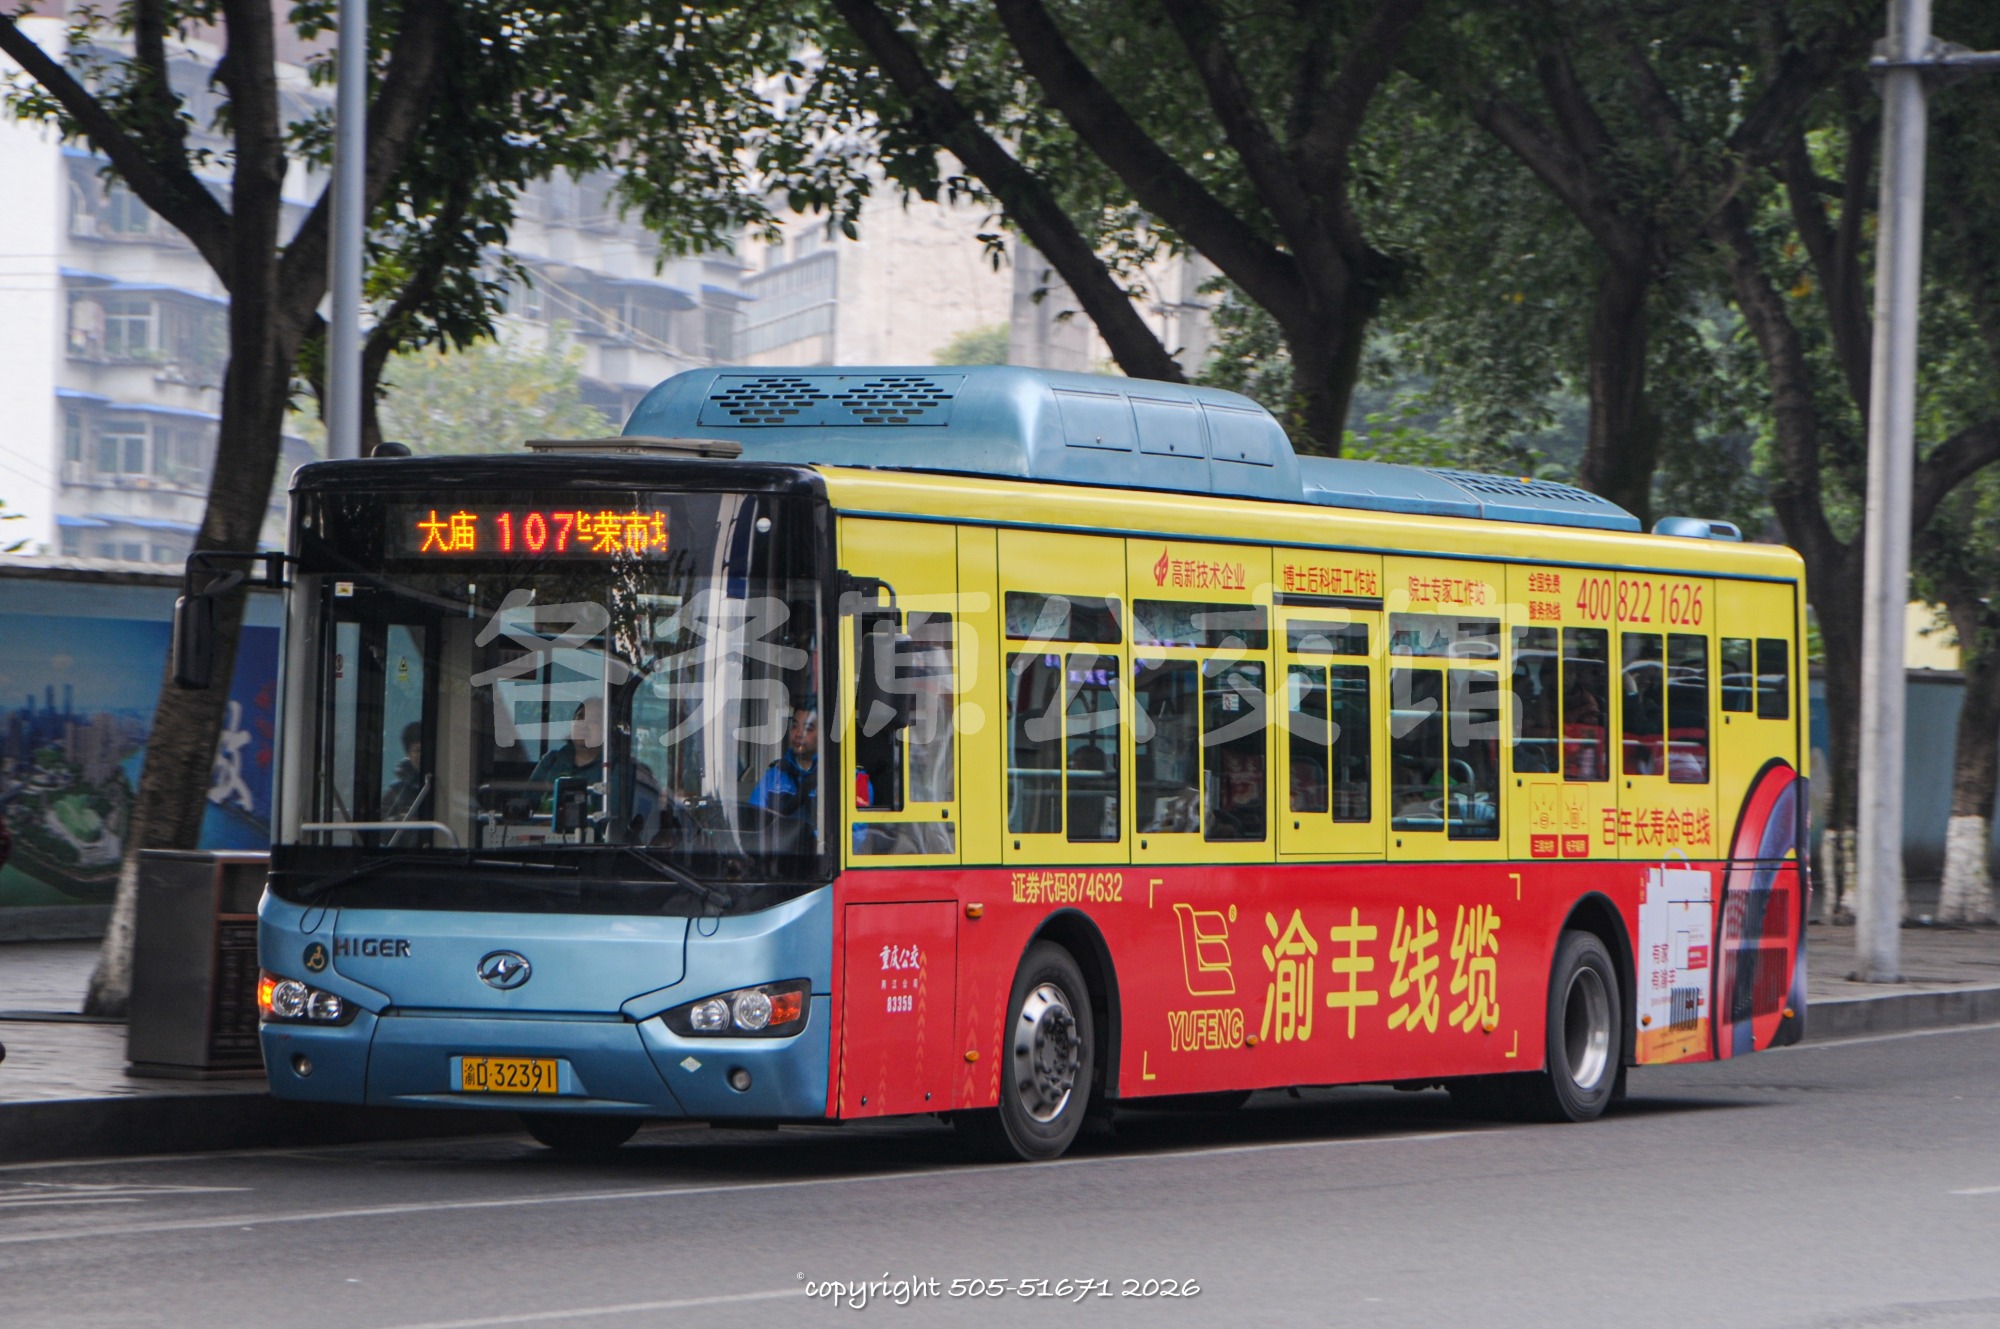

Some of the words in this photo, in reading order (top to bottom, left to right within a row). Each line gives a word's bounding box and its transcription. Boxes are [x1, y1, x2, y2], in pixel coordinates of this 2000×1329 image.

[418, 510, 476, 551] 大庙
[498, 512, 574, 552] 107
[1171, 560, 1246, 590] 高新技术企业
[1283, 564, 1377, 595] 博士后科研工作站
[1528, 572, 1561, 594] 全国免费
[1408, 576, 1486, 606] 院士专家工作站
[1576, 577, 1612, 621] 400
[1616, 579, 1652, 623] 822
[1660, 582, 1703, 626] 1626
[1528, 601, 1561, 621] 服务热线
[1602, 807, 1711, 847] 百年长寿命电线
[1011, 872, 1123, 903] 证券代码874632
[333, 938, 411, 957] HIGER
[1260, 904, 1501, 1044] 渝丰线缆
[1168, 1008, 1245, 1052] YUFENG
